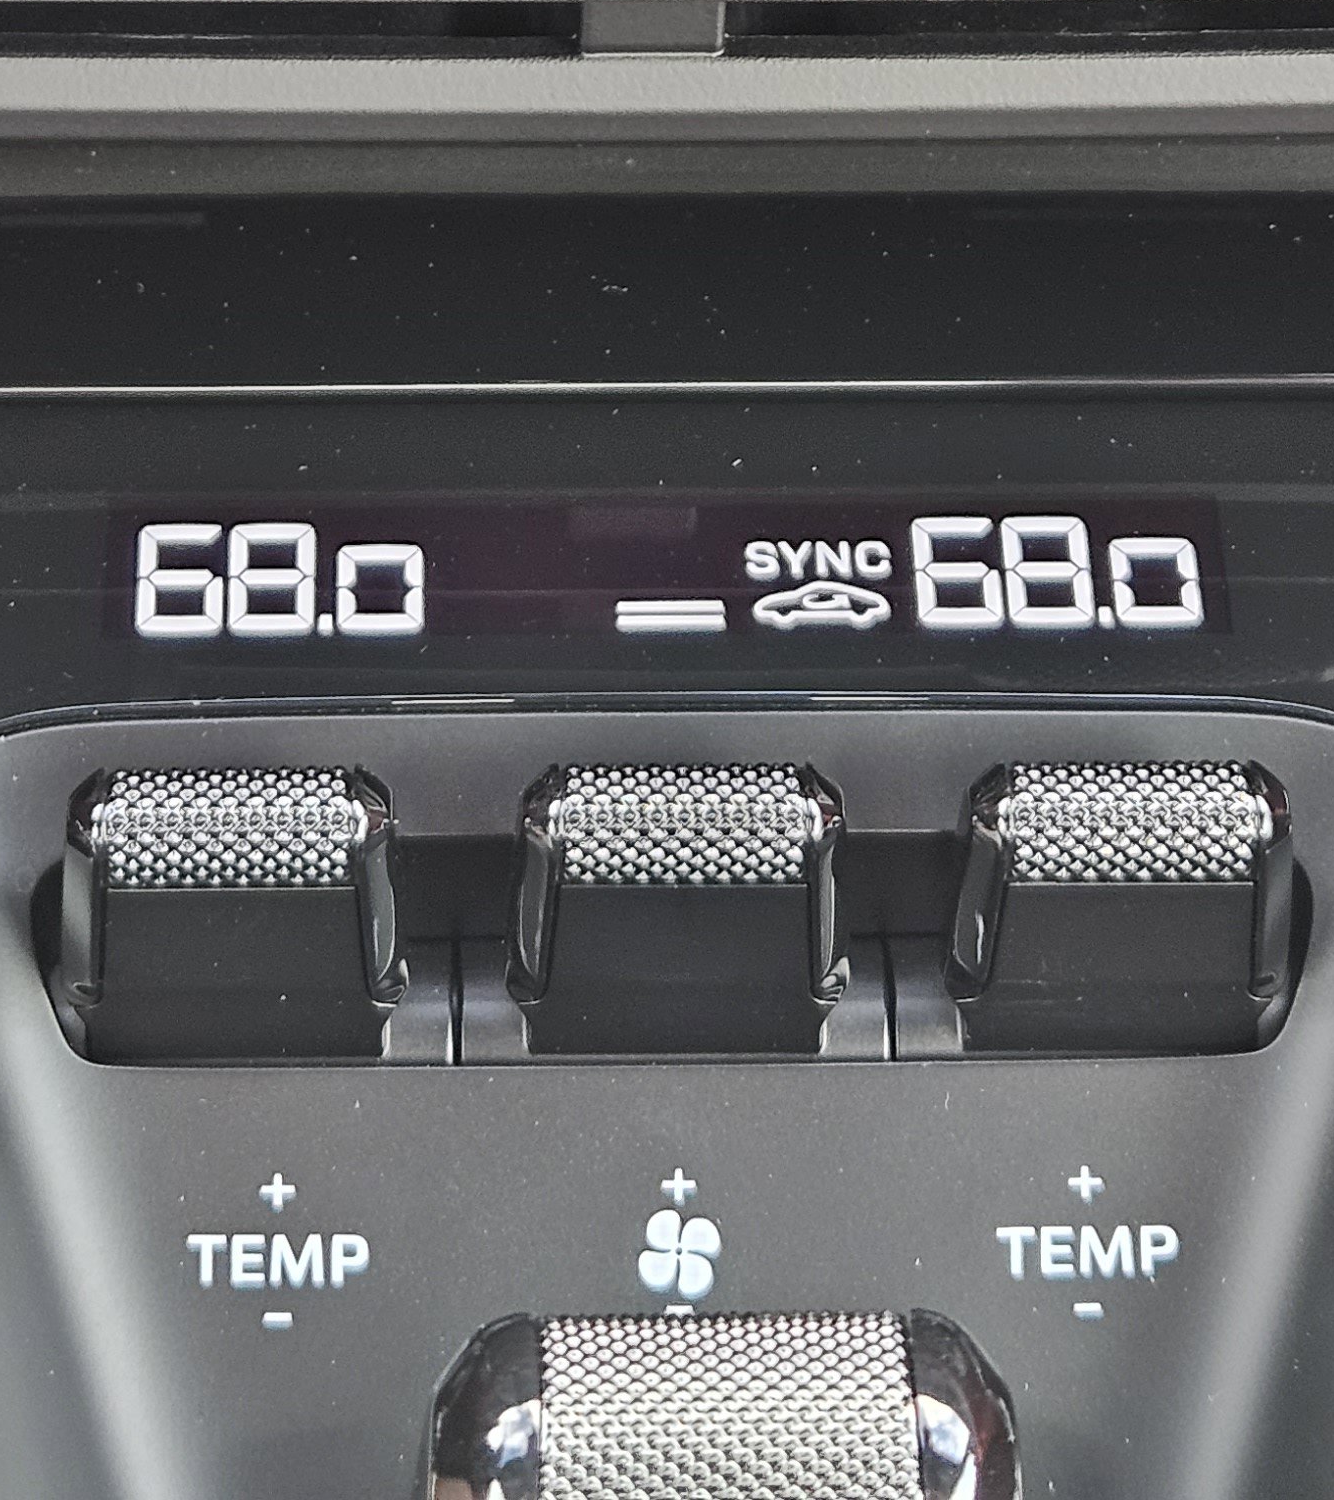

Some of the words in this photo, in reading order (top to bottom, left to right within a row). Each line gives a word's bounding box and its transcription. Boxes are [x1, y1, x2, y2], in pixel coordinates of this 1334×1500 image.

[135, 522, 425, 635] 68.0
[744, 540, 892, 580] SYNC
[911, 516, 1204, 629] 68.0
[186, 1234, 371, 1287] TEMP
[995, 1225, 1180, 1278] TEMP
